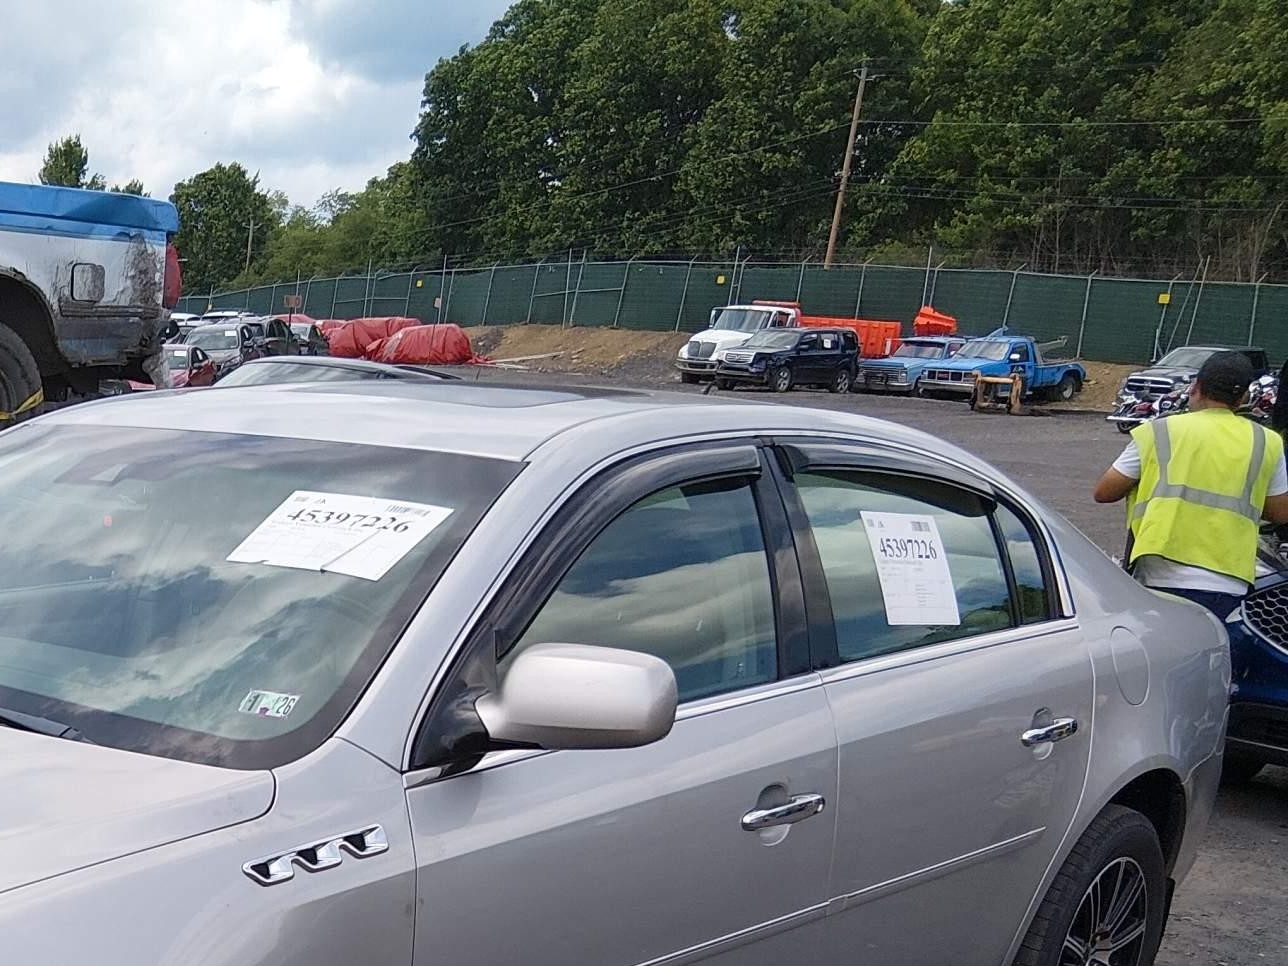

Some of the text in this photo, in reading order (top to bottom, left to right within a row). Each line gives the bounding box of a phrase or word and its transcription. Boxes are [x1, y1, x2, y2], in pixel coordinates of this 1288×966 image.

[288, 508, 414, 533] 45397226
[879, 537, 937, 560] 45397226
[275, 697, 296, 715] 26
